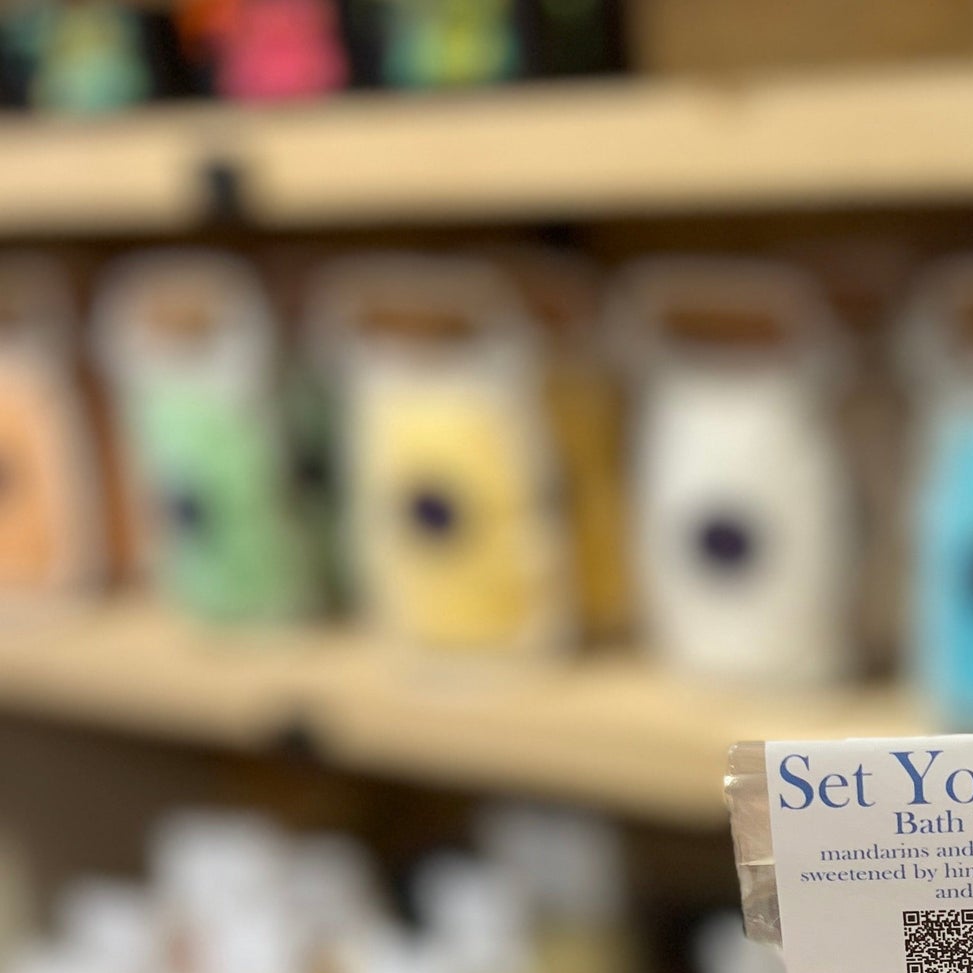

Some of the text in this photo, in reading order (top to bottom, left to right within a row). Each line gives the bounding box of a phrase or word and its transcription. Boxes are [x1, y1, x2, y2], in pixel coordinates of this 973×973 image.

[780, 755, 875, 810] Set
[895, 810, 964, 834] Bath
[821, 843, 929, 860] mandarins
[937, 841, 973, 857] and
[801, 864, 906, 881] sweetened
[913, 864, 937, 882] by
[935, 883, 973, 899] and
